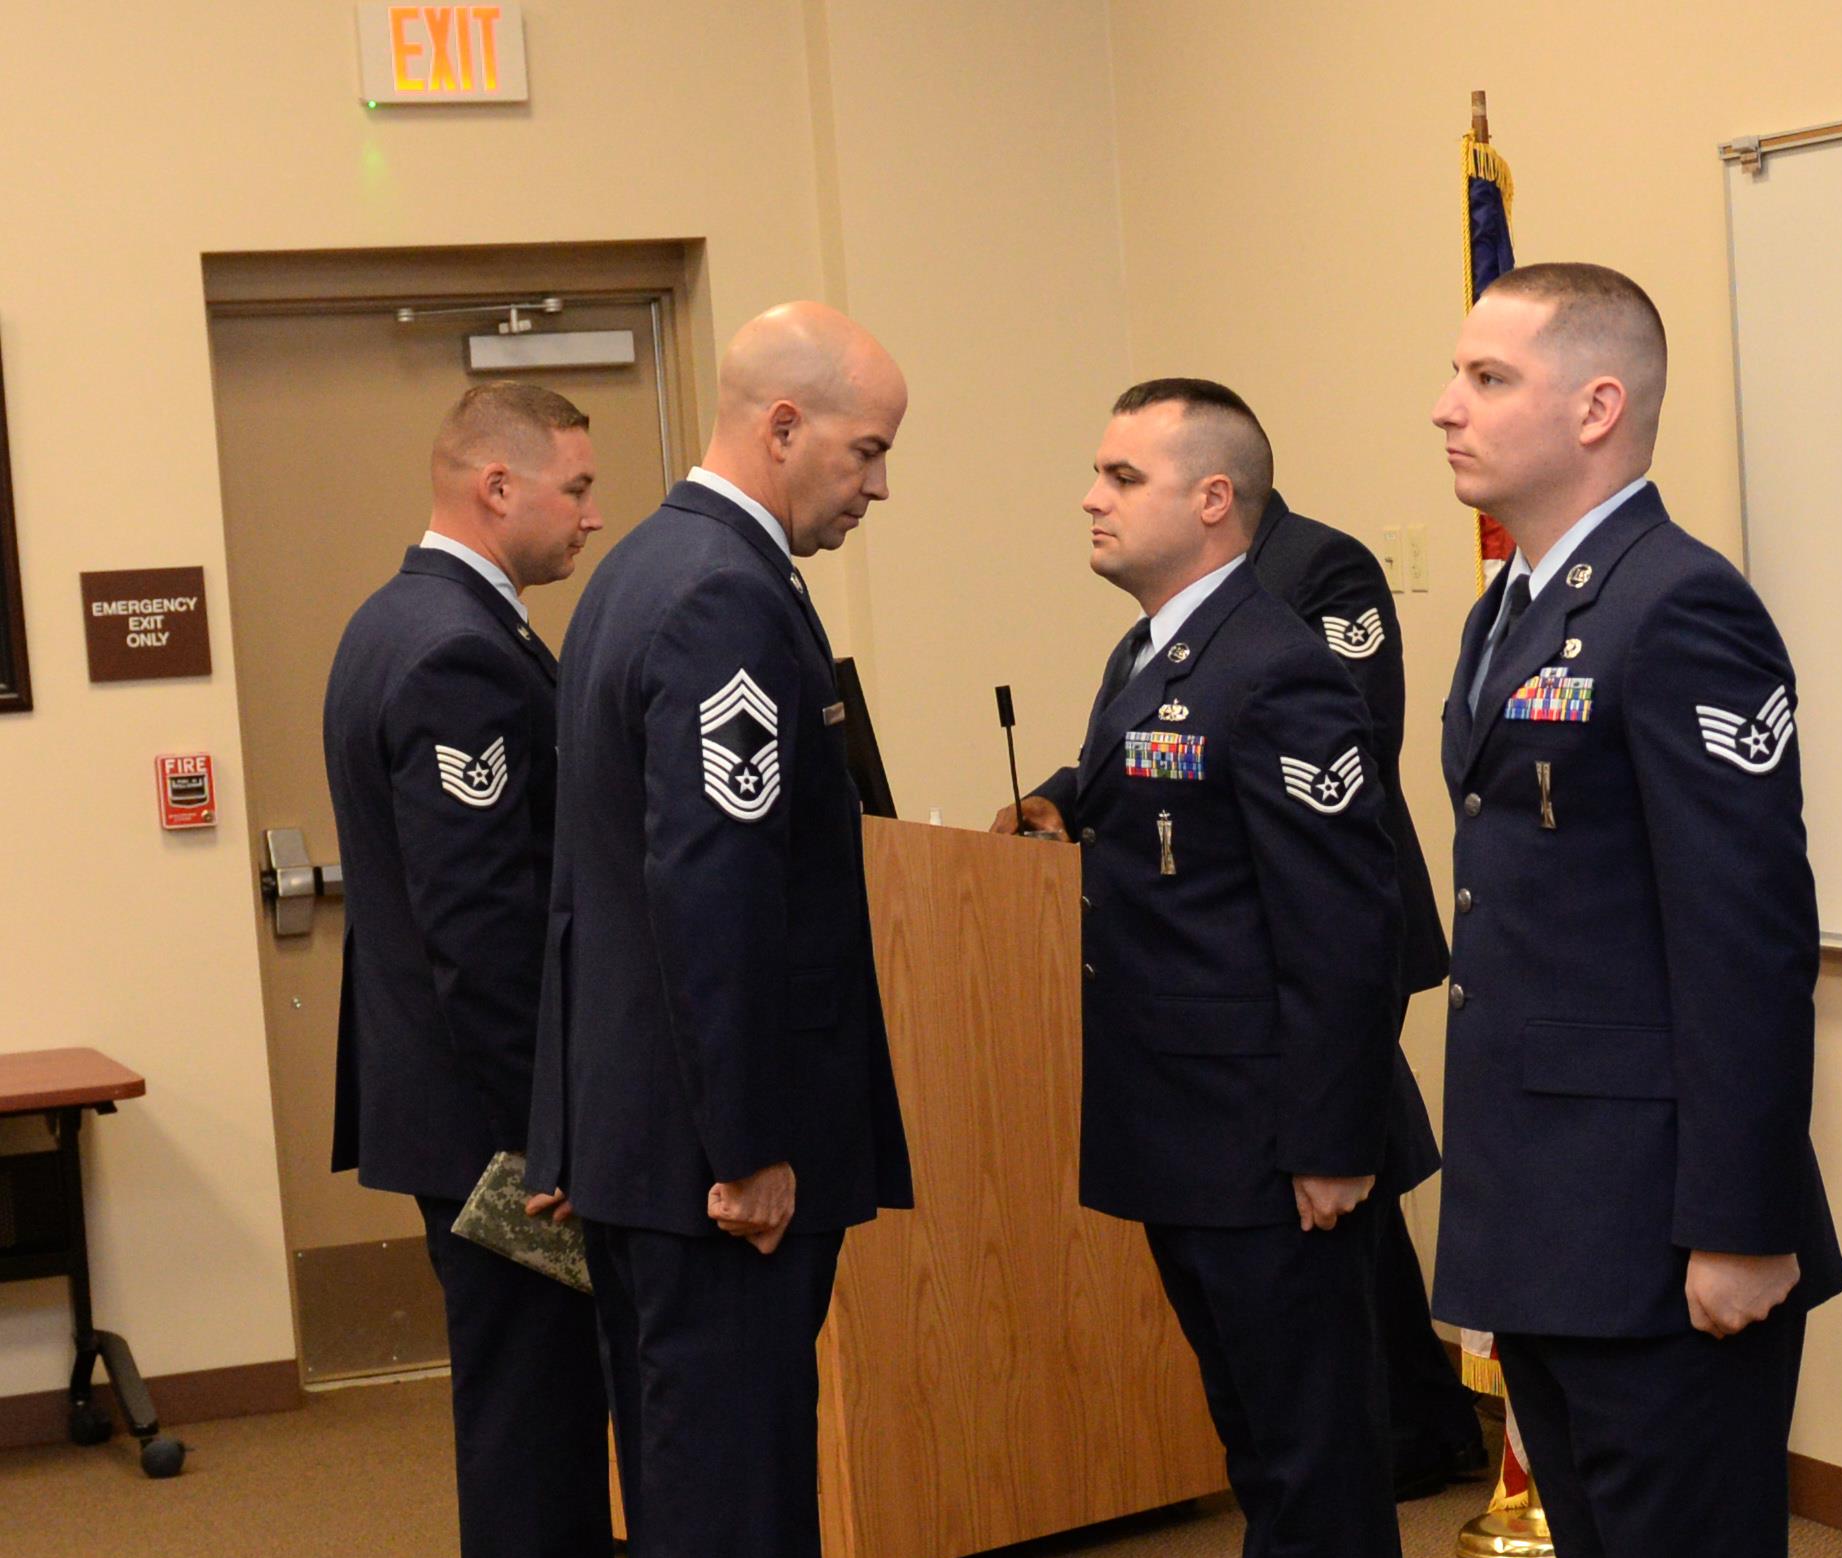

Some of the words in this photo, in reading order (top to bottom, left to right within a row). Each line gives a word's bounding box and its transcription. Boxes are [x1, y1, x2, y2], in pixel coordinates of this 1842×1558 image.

[389, 6, 501, 93] EXIT
[92, 597, 198, 617] EMERGENCY
[128, 615, 165, 631] EXIT
[126, 632, 170, 648] ONLY
[164, 757, 208, 774] FIRE
